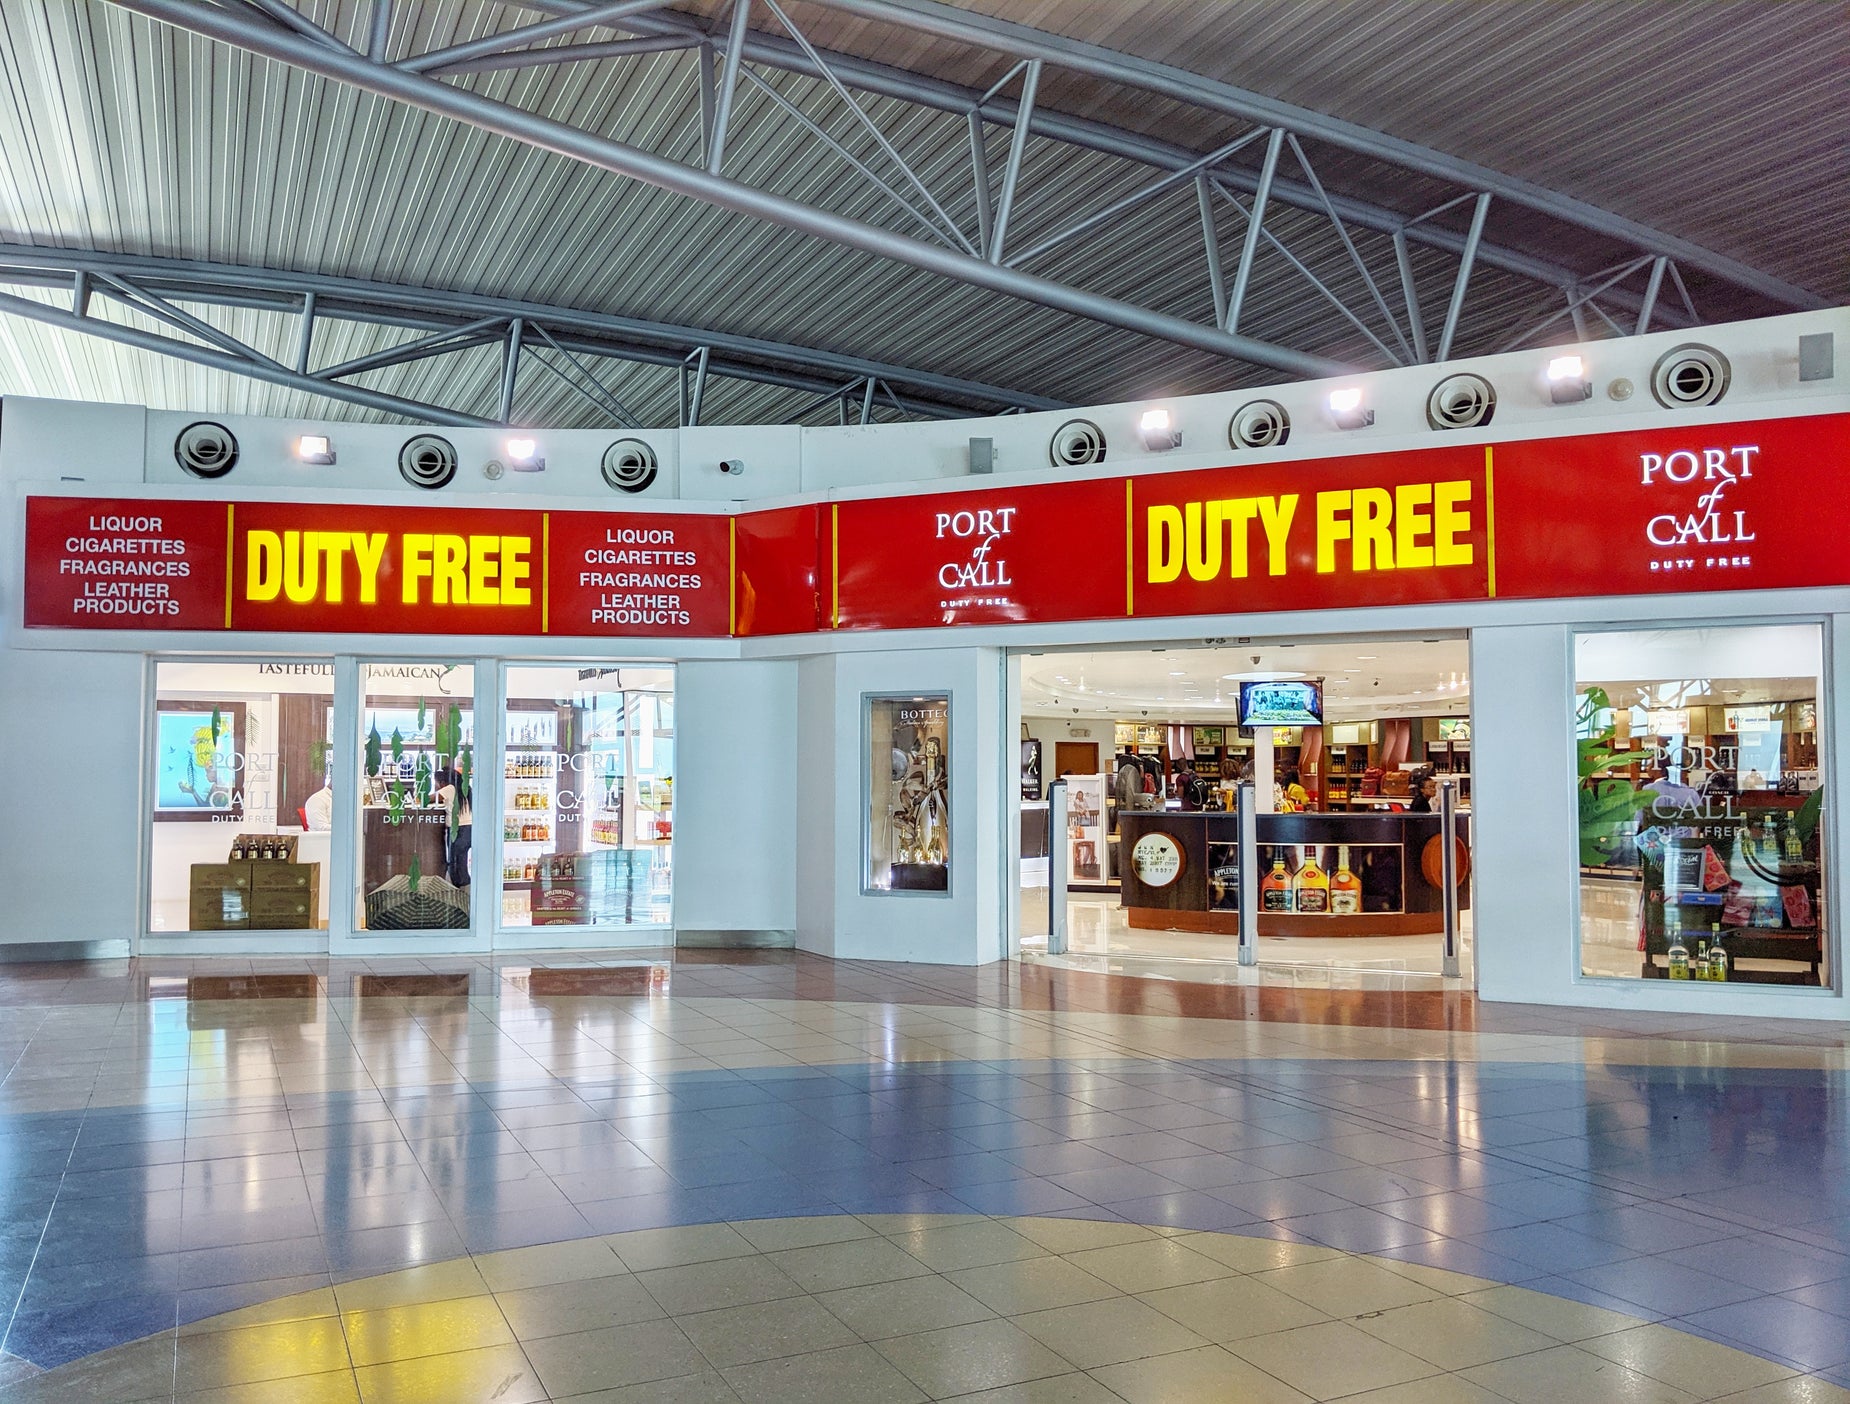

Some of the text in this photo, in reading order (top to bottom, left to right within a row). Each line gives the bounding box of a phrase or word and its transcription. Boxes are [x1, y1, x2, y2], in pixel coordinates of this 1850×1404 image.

[1640, 446, 1759, 484] PORT
[1697, 478, 1737, 526] of
[89, 516, 162, 532] LIQUOR
[936, 508, 1016, 538] PORT
[1646, 511, 1755, 545] CALL
[606, 529, 674, 544] LIQUOR
[1147, 480, 1473, 584] DUTY FREE
[65, 537, 186, 555] CIGARETTES
[973, 533, 1000, 574] of
[584, 549, 697, 565] CIGARETTES
[1650, 557, 1751, 570] DUTY FREE
[60, 559, 191, 577] FRAGRANCES
[247, 530, 531, 605] DUTY FREE
[938, 561, 1012, 589] CALL
[579, 572, 702, 589] FRAGRANCES
[84, 582, 169, 598] LEATHER
[73, 598, 180, 615] PRODUCTS
[601, 593, 680, 609] LEATHER
[940, 598, 1009, 608] DUTY FREE
[591, 609, 690, 625] PRODUCTS
[258, 664, 441, 678] TASTEFULL JAMAICAN
[1652, 746, 1743, 771] PORT
[381, 790, 448, 810] CALL
[1651, 795, 1744, 820] CALL
[212, 815, 275, 824] DUTY FREE
[383, 815, 446, 824] DUTY FREE
[558, 814, 582, 822] DUT
[1704, 826, 1742, 837] FREE
